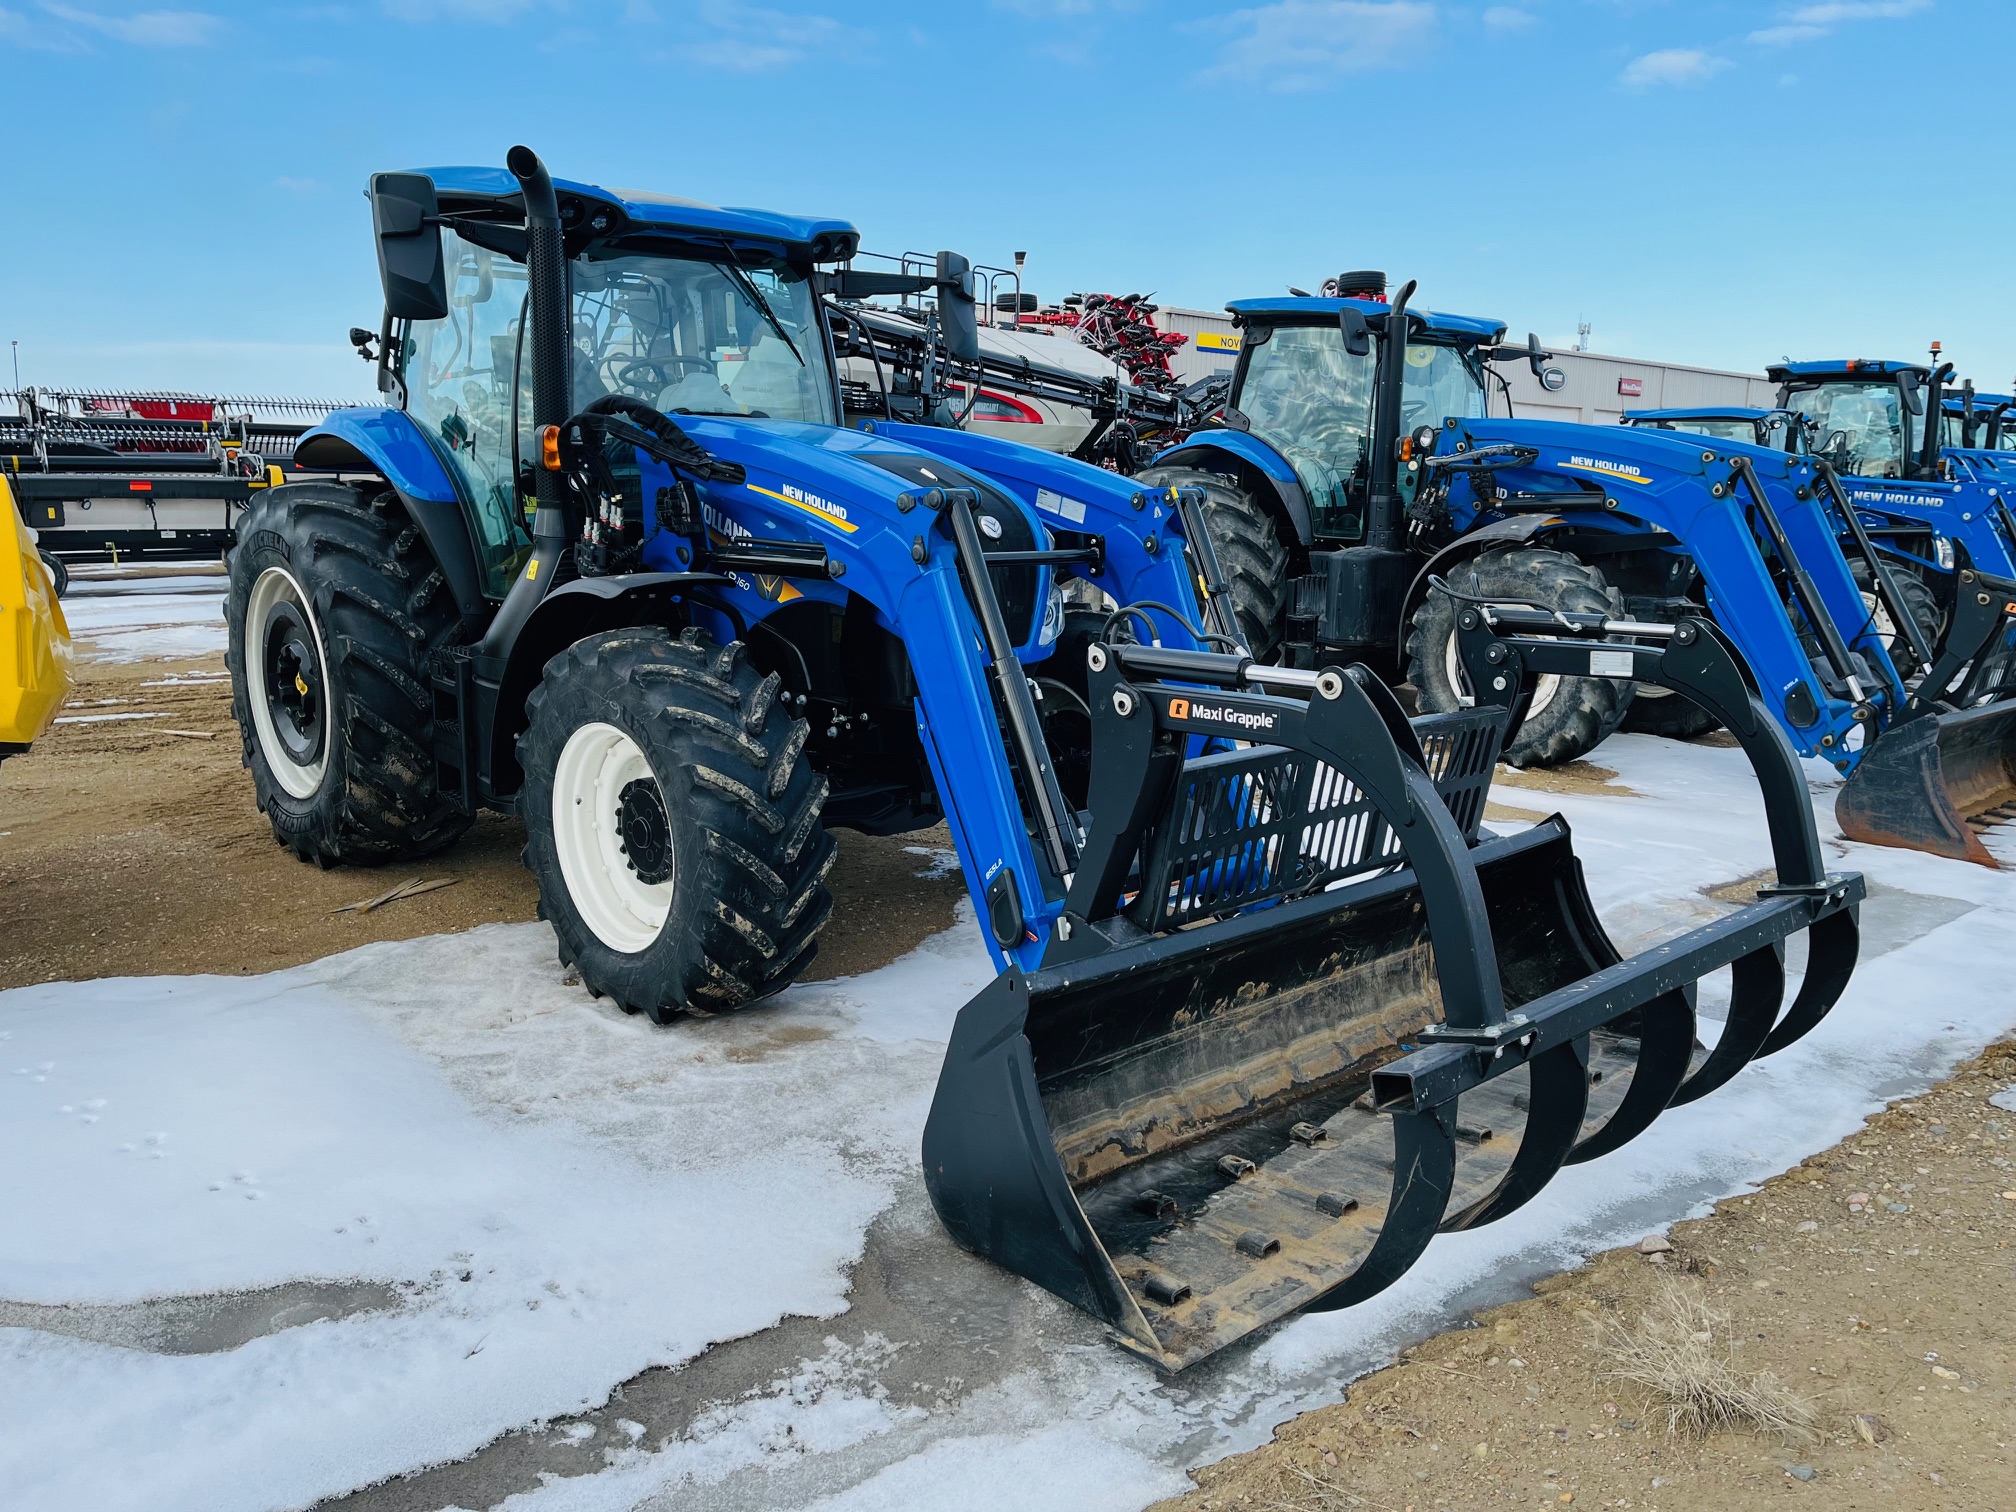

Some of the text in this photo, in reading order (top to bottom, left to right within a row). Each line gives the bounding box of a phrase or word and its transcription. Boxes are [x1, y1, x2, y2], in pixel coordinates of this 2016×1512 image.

[1221, 338, 1241, 348] NOV
[1571, 455, 1641, 476] NEW HOLLAND
[782, 483, 847, 520] NEW HOLLAND
[1853, 490, 1944, 507] NEW HOLLAND
[701, 500, 753, 547] OLLAND
[1192, 704, 1222, 721] Maxi
